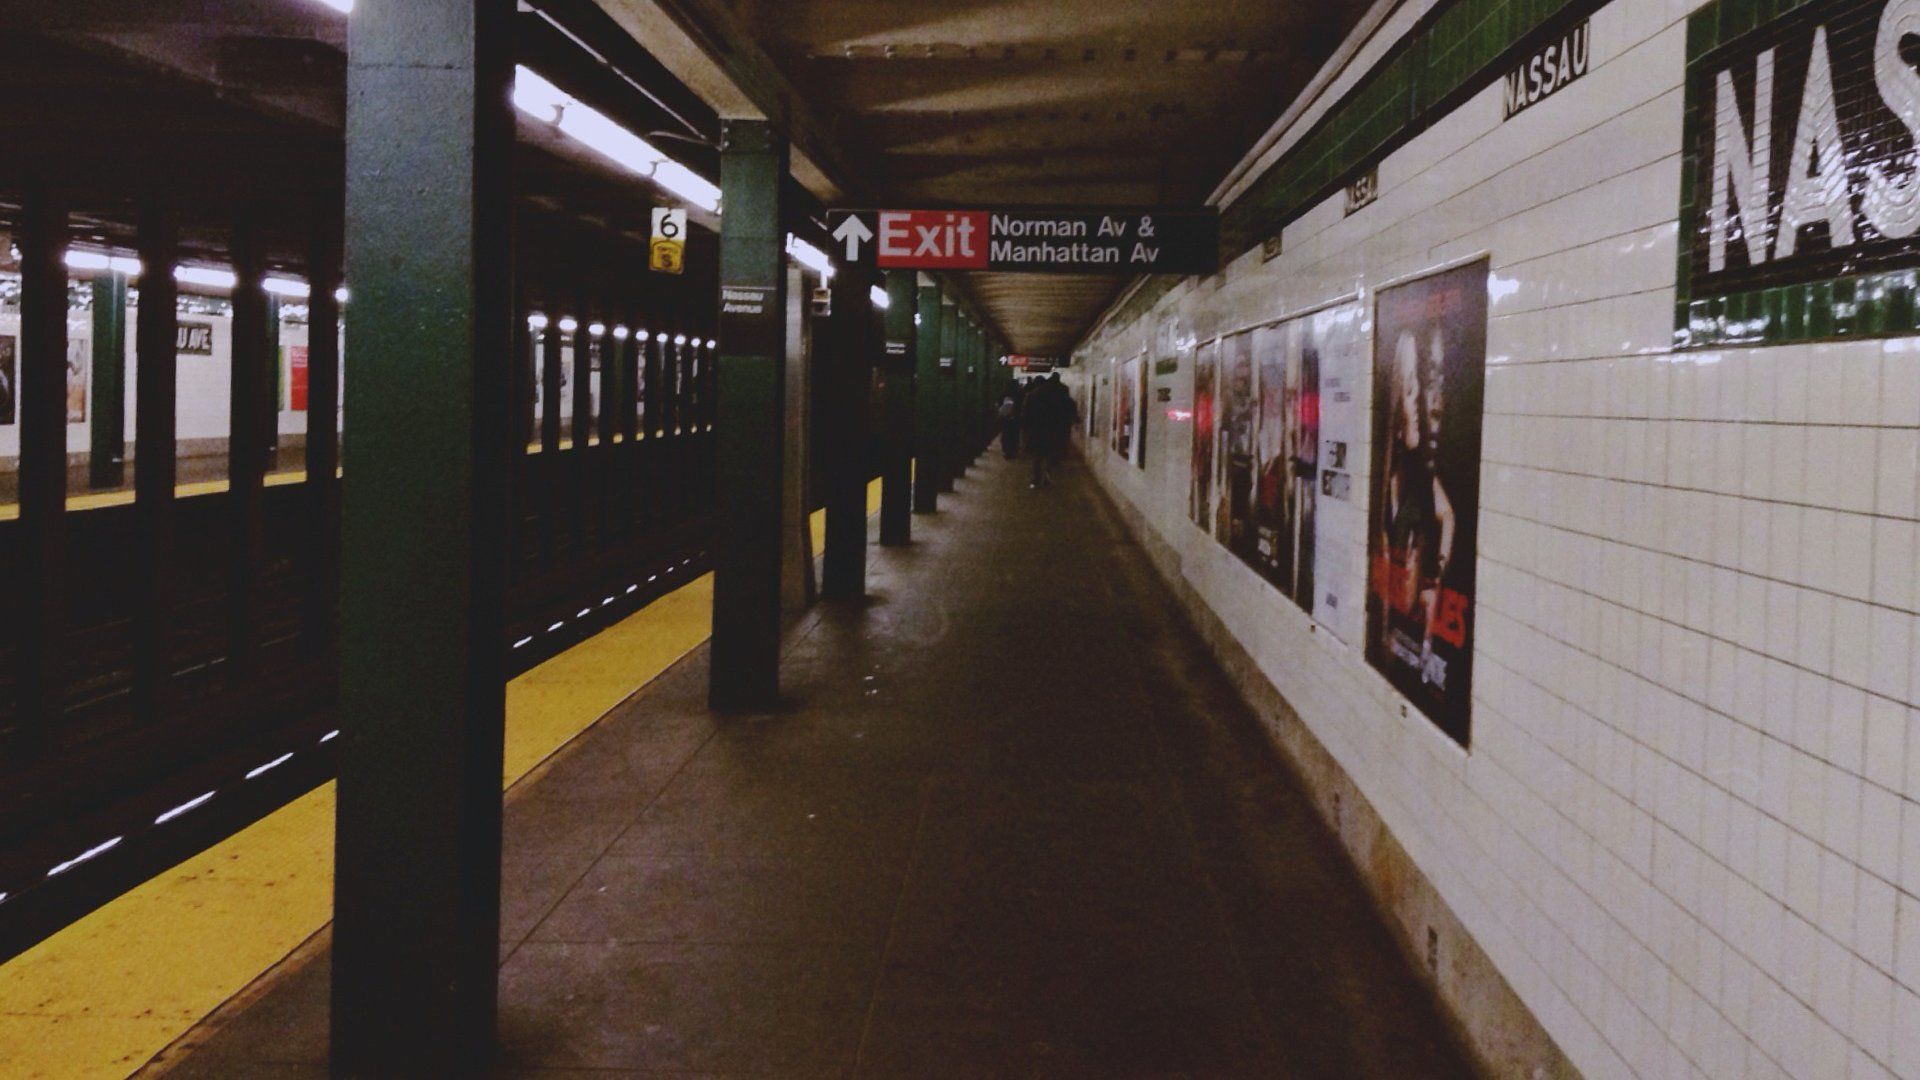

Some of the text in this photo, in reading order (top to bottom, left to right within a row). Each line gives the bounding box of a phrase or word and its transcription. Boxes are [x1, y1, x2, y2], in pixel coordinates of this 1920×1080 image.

[1503, 22, 1588, 121] NASSAU
[660, 213, 679, 238] 6
[878, 212, 975, 258] Exit
[991, 214, 1155, 237] Norman Av &
[990, 240, 1160, 263] Manhattan Av
